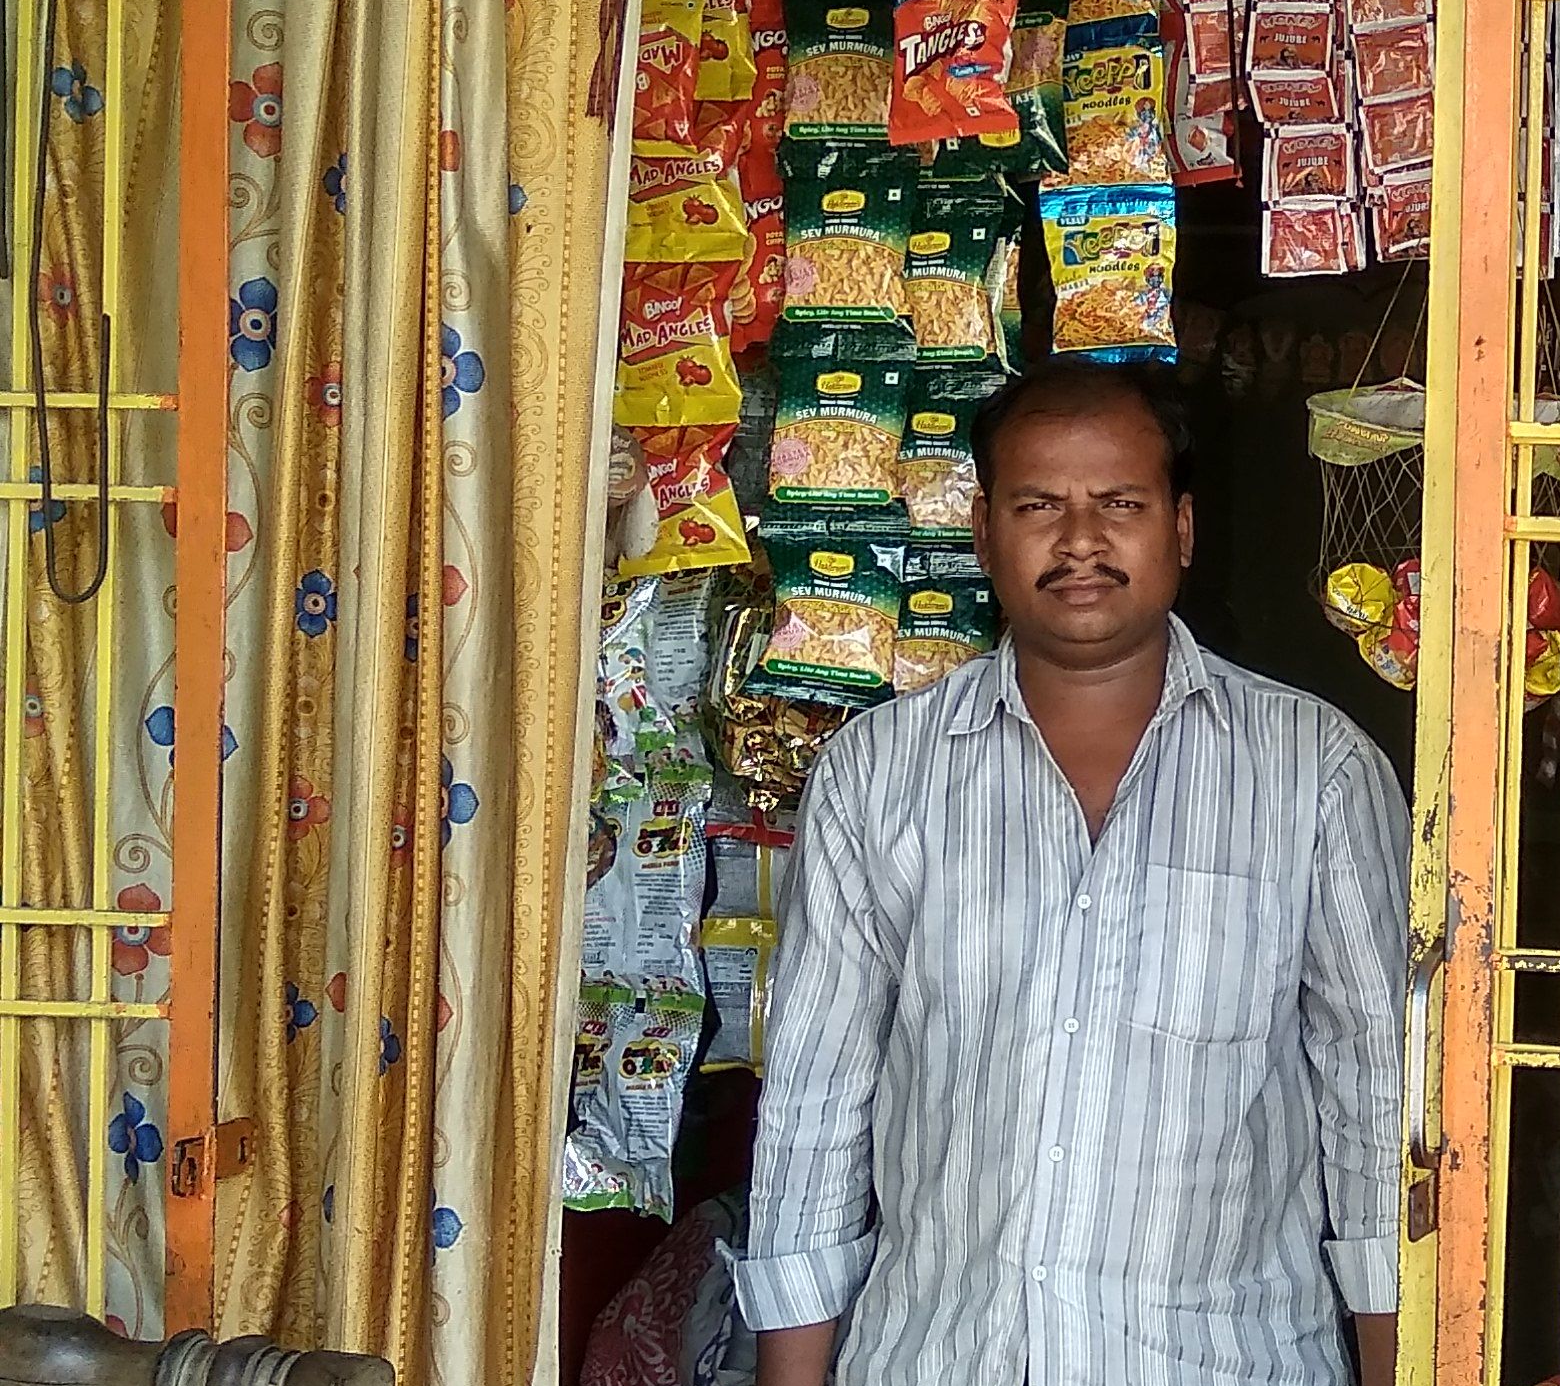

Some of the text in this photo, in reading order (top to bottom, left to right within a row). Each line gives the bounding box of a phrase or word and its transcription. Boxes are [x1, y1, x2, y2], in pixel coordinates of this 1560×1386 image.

[805, 41, 885, 57] SEV MURMURA
[900, 22, 980, 76] TANGLES
[1082, 96, 1132, 110] noodles
[663, 156, 722, 185] ANGLES
[801, 228, 822, 240] SEV
[825, 225, 881, 241] MURMURA
[912, 265, 966, 281] MURMURA
[644, 297, 682, 320] BINGO!
[620, 317, 712, 349] MAD ANGLES
[796, 406, 878, 424] SEV MURMURA
[917, 446, 973, 461] MURMURA
[791, 586, 872, 606] SEV MURMURA
[915, 627, 970, 644] MURMURA
